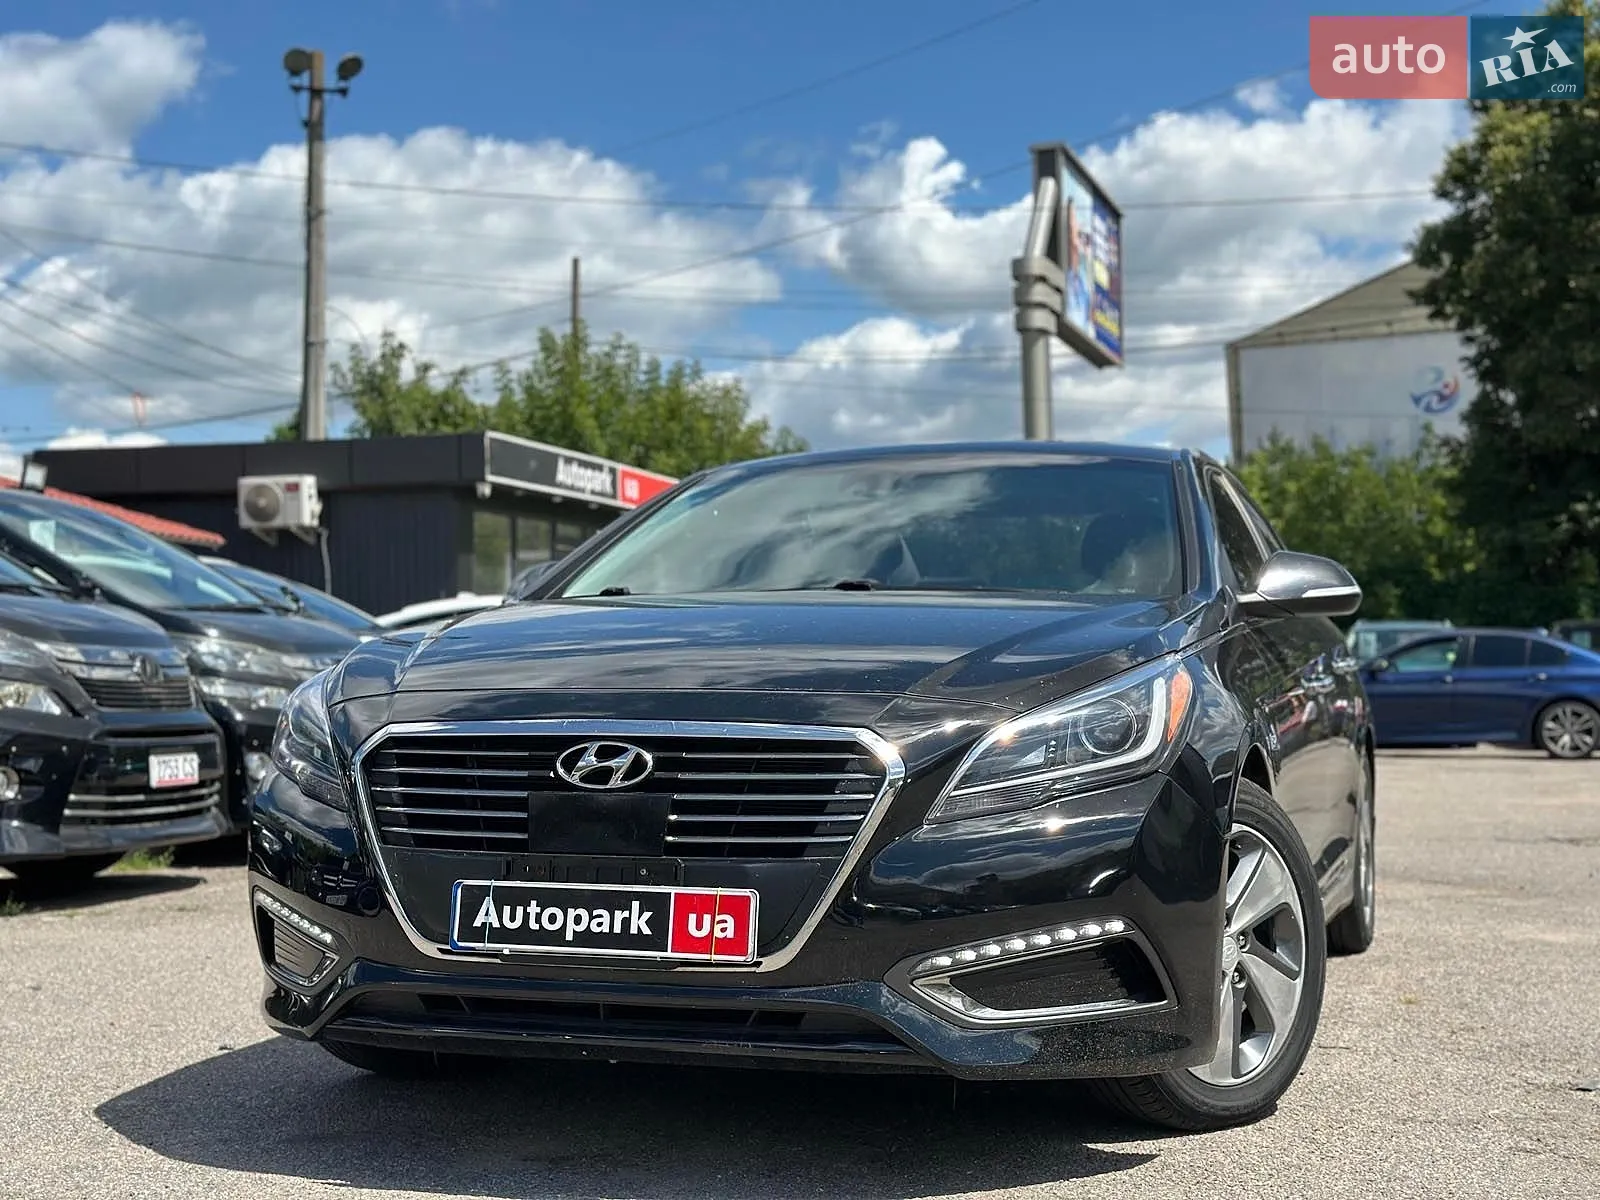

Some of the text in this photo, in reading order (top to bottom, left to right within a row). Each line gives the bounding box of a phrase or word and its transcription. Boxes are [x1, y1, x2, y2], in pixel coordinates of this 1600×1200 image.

[555, 456, 614, 496] Autopark
[473, 897, 735, 941] Autopark ua
